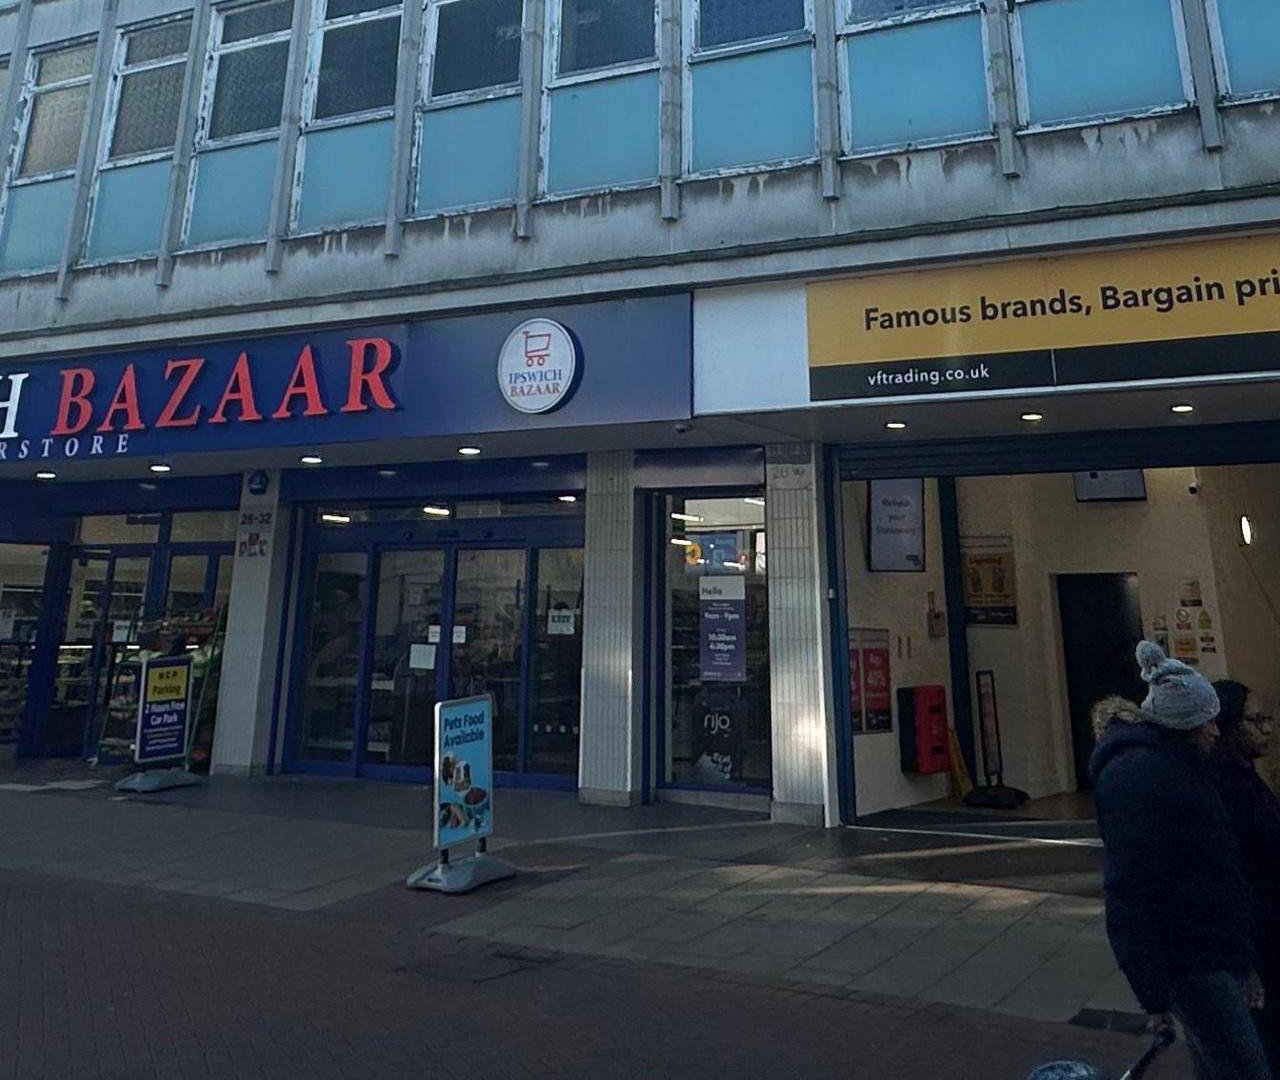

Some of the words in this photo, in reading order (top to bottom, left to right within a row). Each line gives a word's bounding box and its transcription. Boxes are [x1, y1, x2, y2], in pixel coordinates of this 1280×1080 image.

[864, 300, 973, 331] Famous
[980, 288, 1094, 322] brands,
[1100, 280, 1226, 317] Bargain
[508, 369, 562, 385] IPSWICH
[867, 363, 990, 387] vftrading.co.uk
[50, 337, 398, 436] BAZAAR
[510, 382, 560, 398] BAZAAR
[152, 684, 181, 696] Parking
[150, 714, 163, 726] Car
[163, 711, 178, 724] Park
[444, 717, 463, 731] Pets
[463, 710, 485, 727] Food
[444, 727, 485, 748] Available
